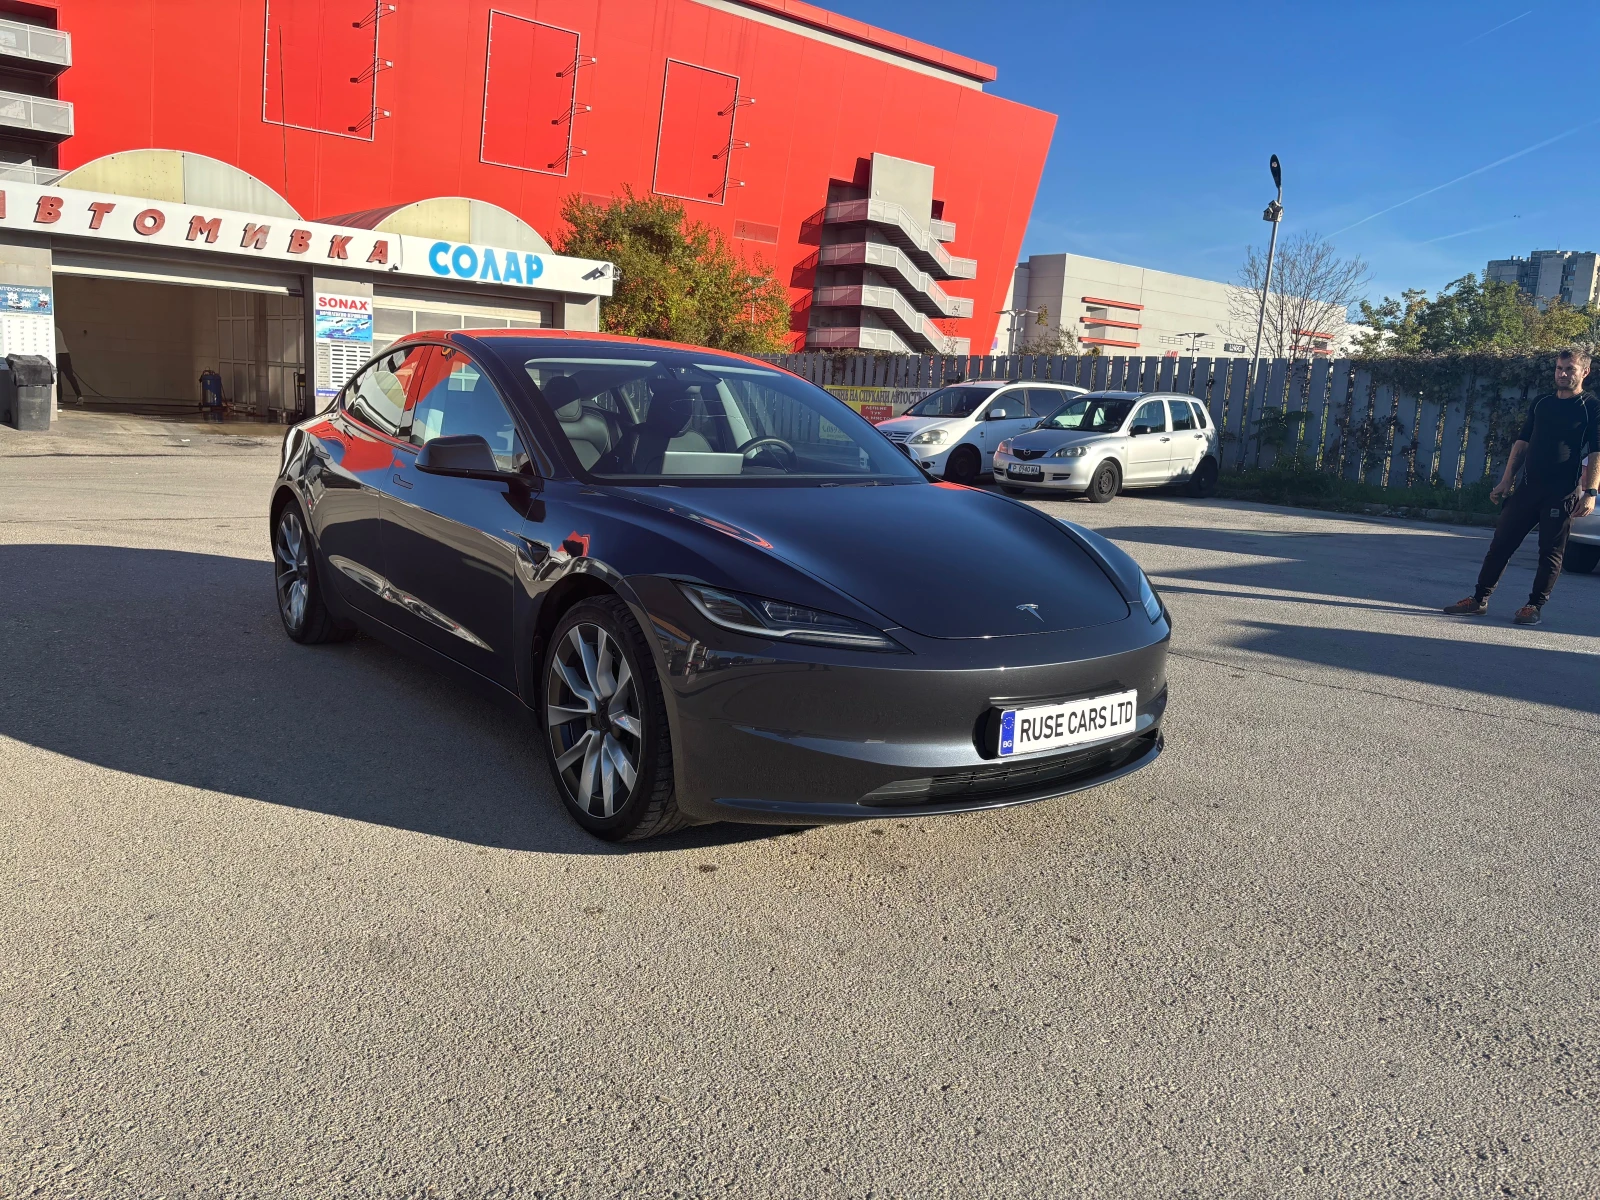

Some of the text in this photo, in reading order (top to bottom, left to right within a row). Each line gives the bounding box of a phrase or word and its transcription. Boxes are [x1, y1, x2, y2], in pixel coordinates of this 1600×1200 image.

[0, 189, 389, 265] ВТОМИВКА
[428, 241, 544, 285] СОЛАР
[318, 296, 368, 311] SONAX
[1019, 700, 1133, 743] RUSE CARS LTD
[1002, 740, 1012, 748] BG
